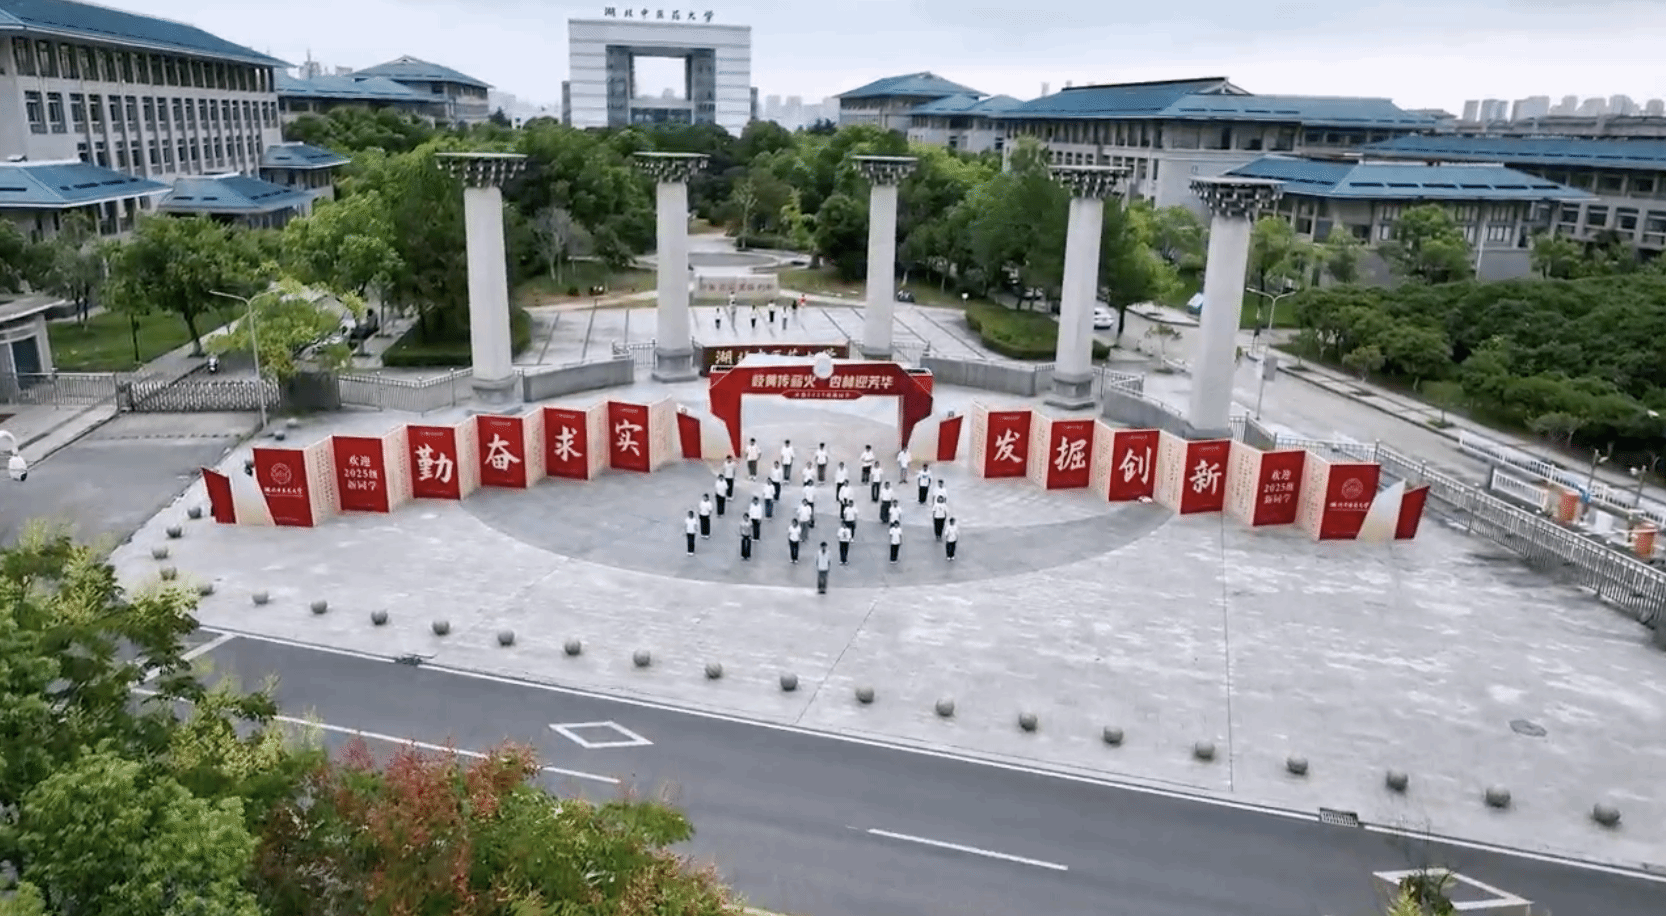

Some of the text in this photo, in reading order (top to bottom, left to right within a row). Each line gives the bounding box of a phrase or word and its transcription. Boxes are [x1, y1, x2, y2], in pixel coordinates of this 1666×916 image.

[484, 433, 521, 471] 奋
[553, 425, 583, 462] 求
[614, 419, 643, 456] 实
[993, 428, 1023, 463] 发
[1054, 436, 1087, 471] 掘
[344, 468, 378, 479] 2025级
[349, 454, 371, 467] 欢迎
[415, 443, 453, 483] 勤
[1118, 446, 1151, 485] 创
[1189, 459, 1222, 495] 新
[347, 479, 377, 491] 新同学
